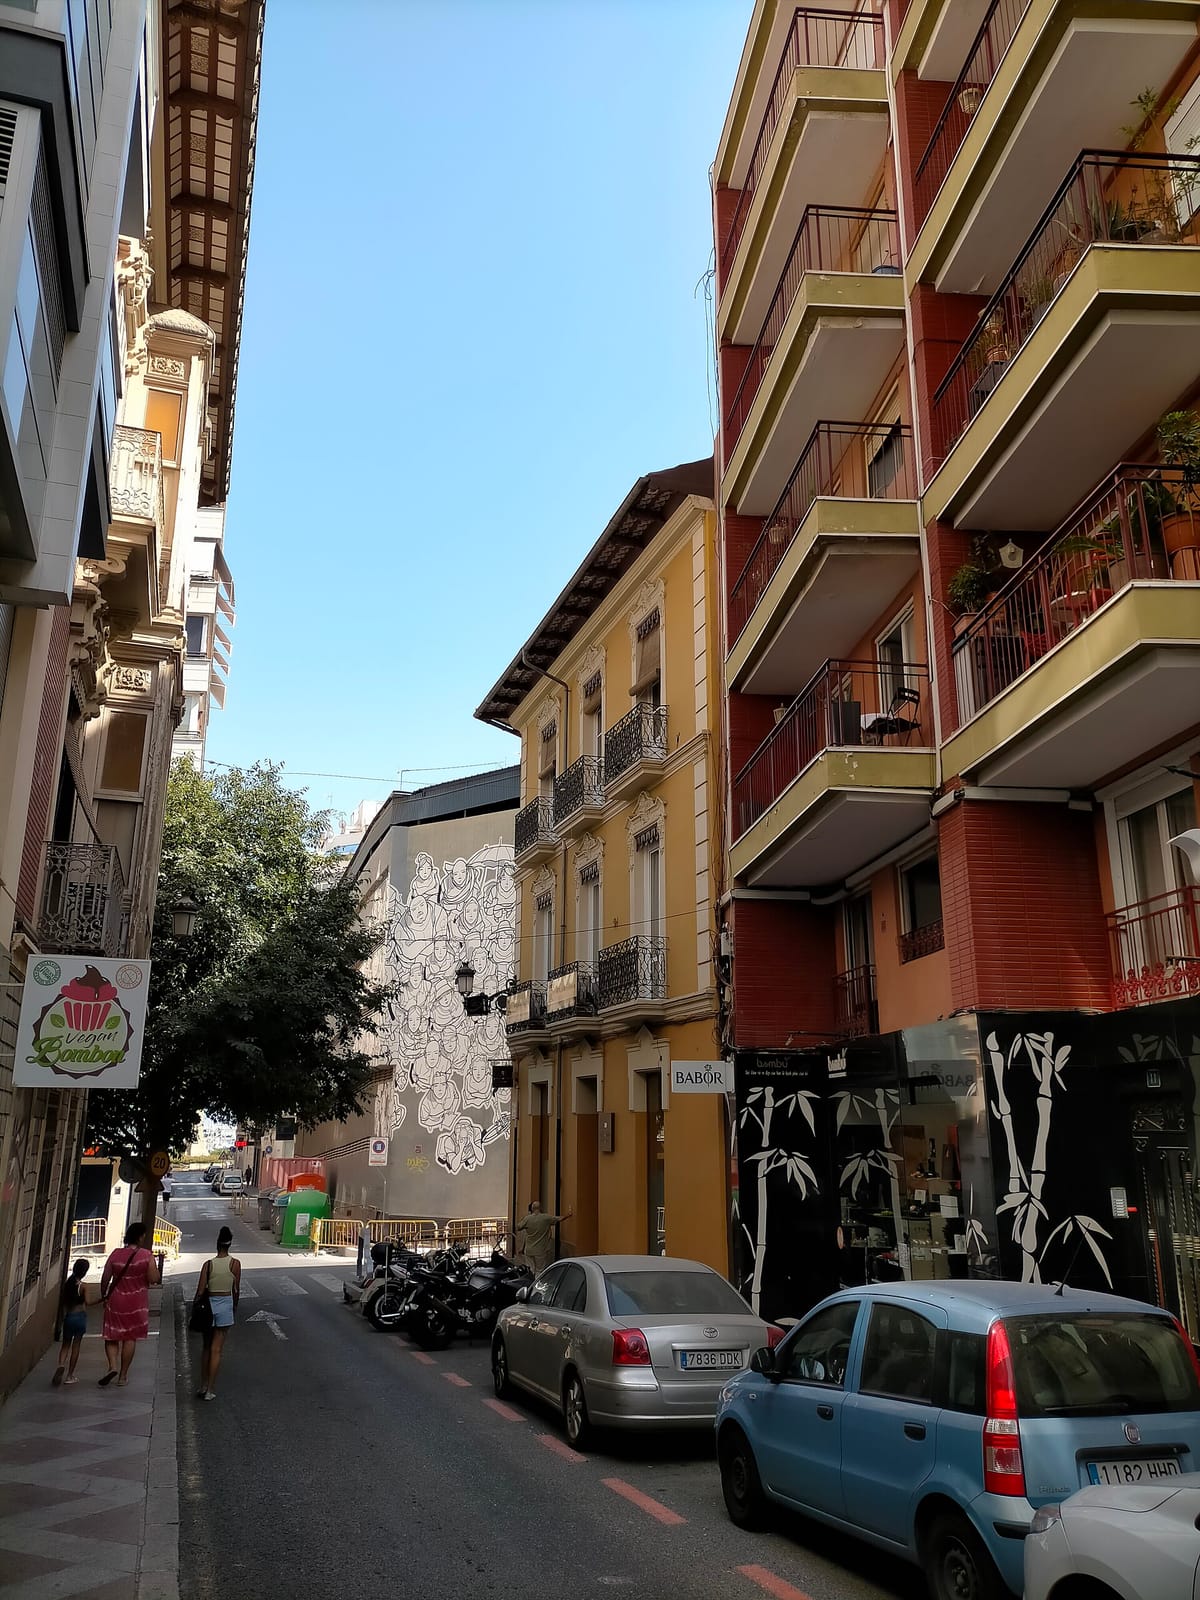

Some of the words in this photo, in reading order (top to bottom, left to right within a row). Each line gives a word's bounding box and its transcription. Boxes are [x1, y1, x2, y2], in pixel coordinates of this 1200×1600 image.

[65, 1032, 118, 1048] Vegan
[676, 1070, 724, 1086] BABOR
[153, 1157, 166, 1169] 20
[688, 1353, 717, 1366] 7836
[719, 1352, 740, 1365] DDK
[1101, 1464, 1142, 1485] 1182
